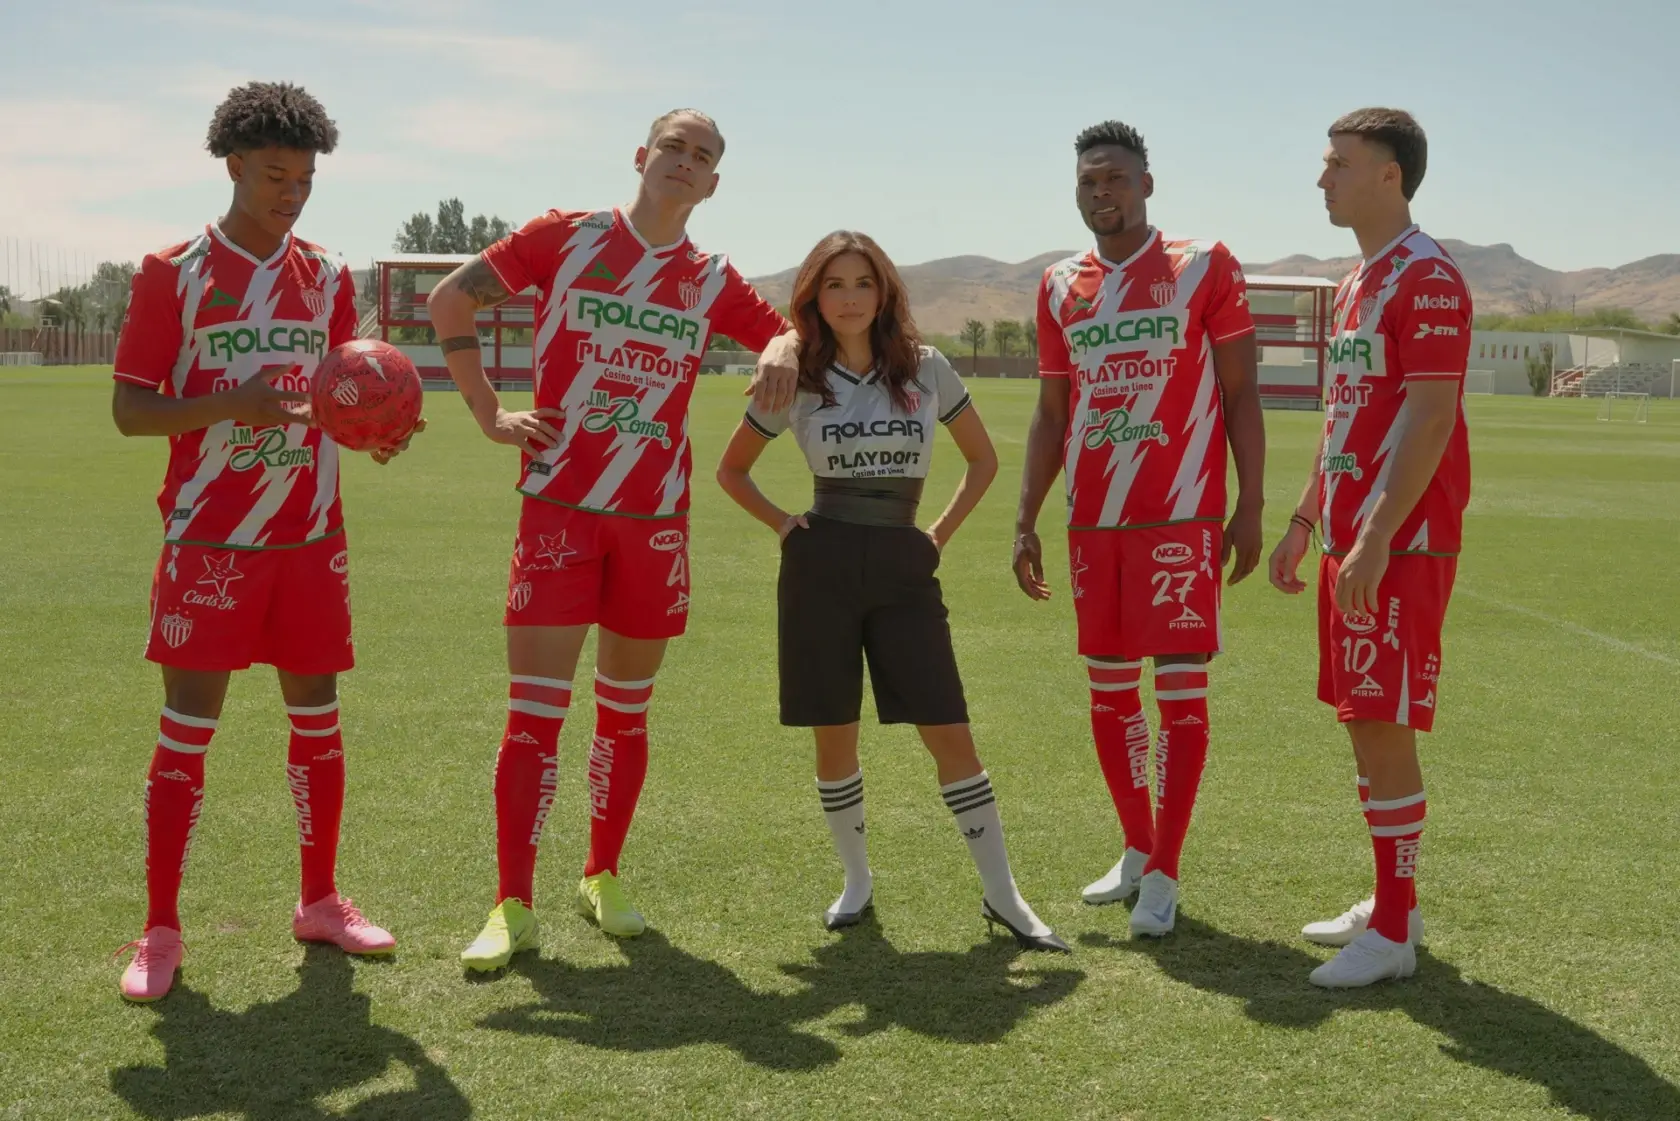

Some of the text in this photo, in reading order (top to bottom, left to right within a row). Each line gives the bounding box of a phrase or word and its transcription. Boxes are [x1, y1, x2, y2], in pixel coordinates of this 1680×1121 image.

[1414, 294, 1459, 310] Mobil
[578, 296, 699, 349] ROLCAR
[1071, 316, 1179, 356] ROLCAR
[208, 326, 327, 362] ROLCAR
[579, 342, 691, 381] PLAYDOIT
[1077, 358, 1175, 388] PLAYDOIT
[604, 368, 631, 382] Casino
[633, 375, 643, 384] en
[1093, 384, 1117, 396] Casino
[1120, 385, 1129, 393] en
[584, 398, 666, 438] Romo
[1086, 407, 1160, 448] Romo
[229, 427, 254, 445] J.M.
[822, 420, 924, 444] ROLCAR
[231, 426, 312, 470] Romo
[827, 451, 920, 471] PLAYDOIT
[652, 532, 682, 546] NOEL
[1155, 546, 1189, 558] NOEL
[1151, 570, 1198, 607] 27
[1169, 621, 1207, 630] PIRMA
[1341, 636, 1377, 674] 10
[1351, 689, 1385, 697] PIRMA
